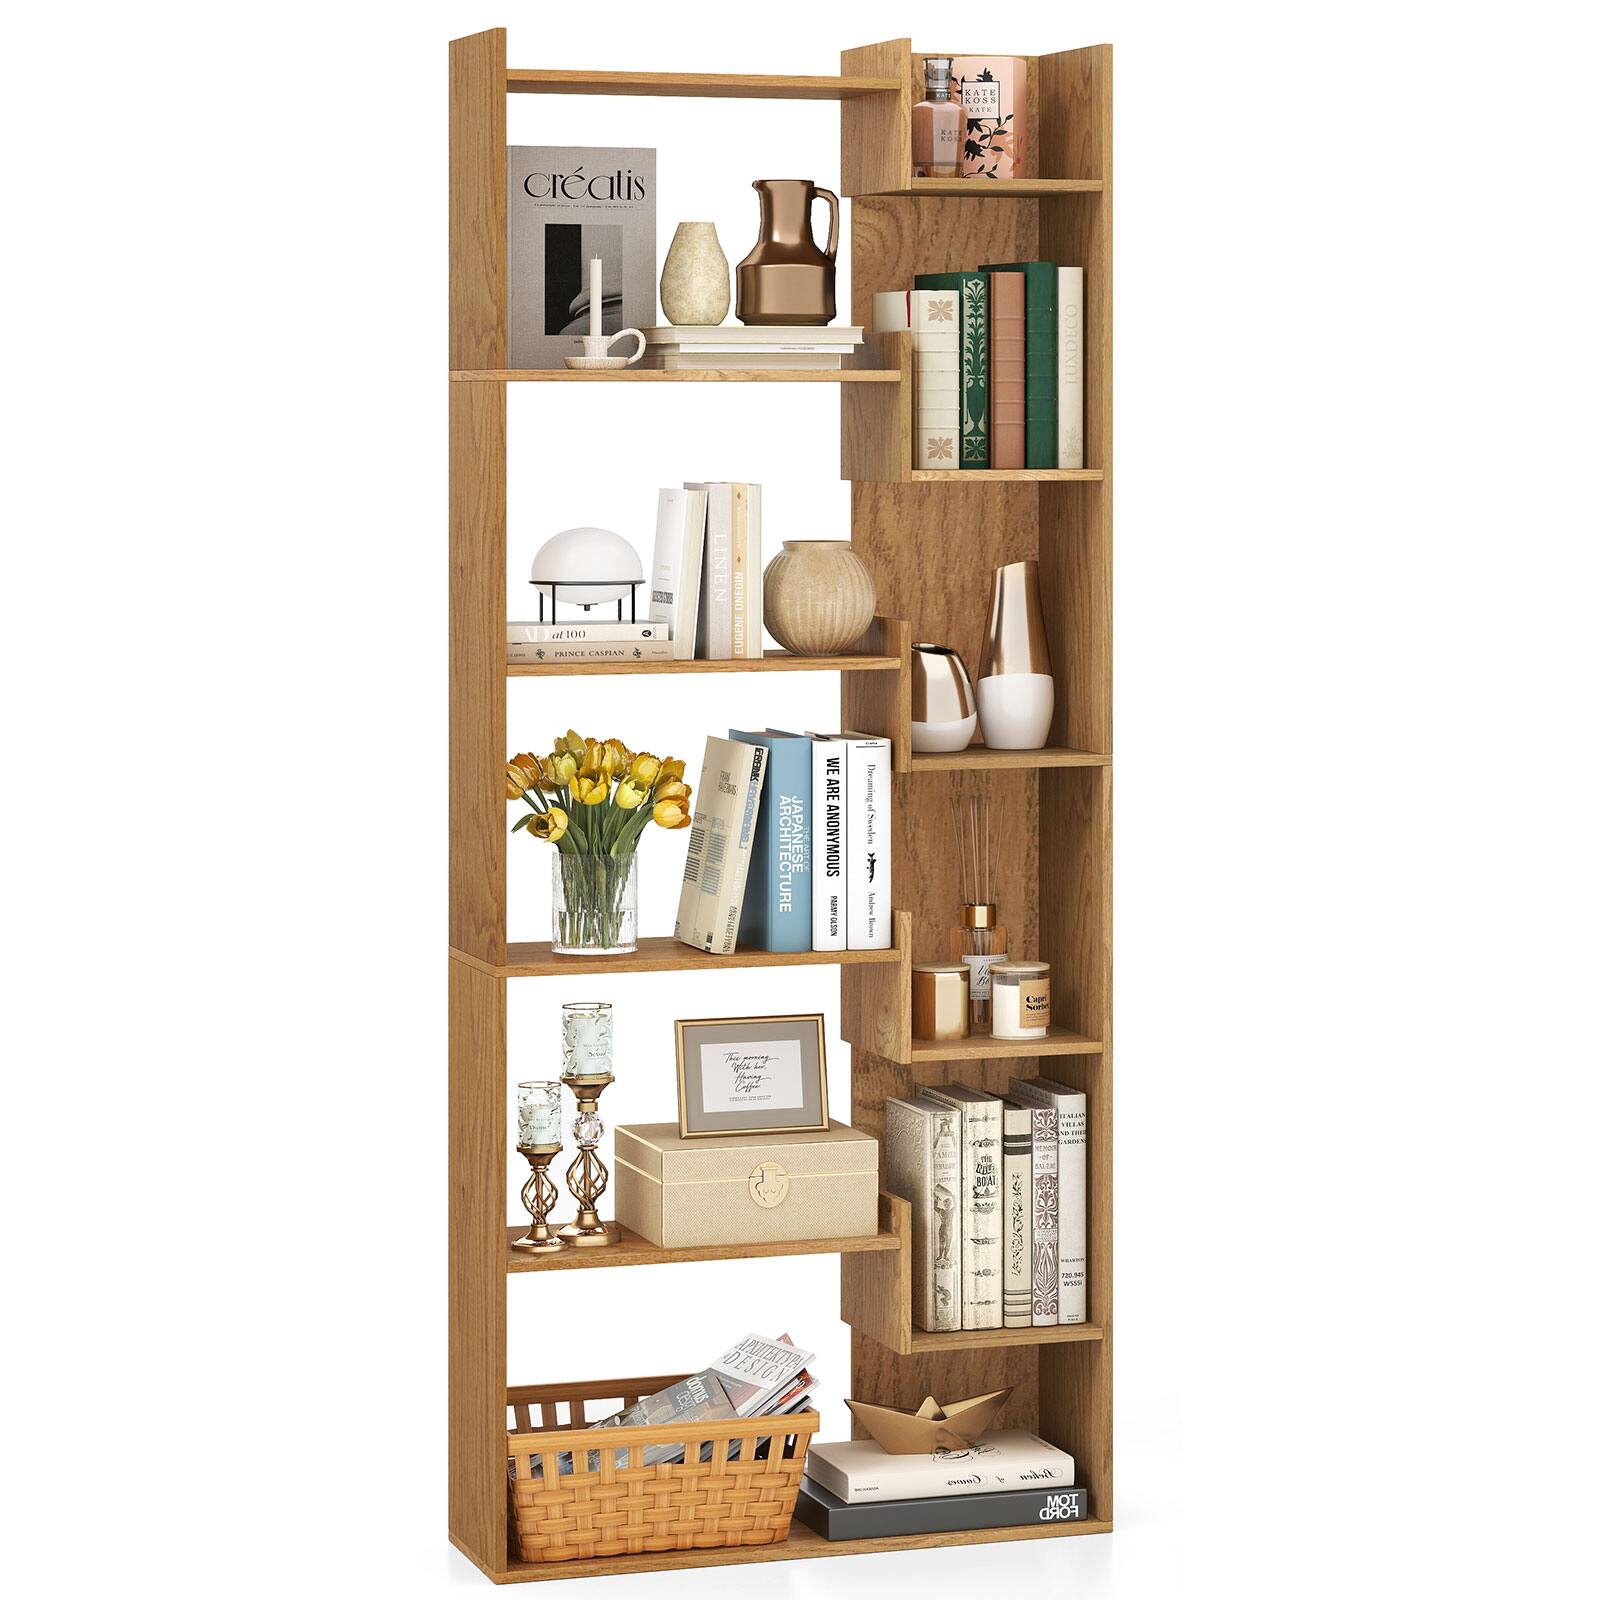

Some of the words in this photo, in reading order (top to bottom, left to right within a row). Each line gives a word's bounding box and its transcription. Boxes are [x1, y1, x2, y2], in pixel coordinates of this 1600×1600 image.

[523, 166, 646, 201] créatis
[714, 534, 728, 601] LINEN
[734, 571, 744, 611] ONEGIN
[566, 630, 586, 639] 100
[734, 613, 744, 655] EUGENE
[554, 650, 586, 658] PRINCE
[588, 649, 625, 657] CASPIAN
[826, 757, 840, 775] WE
[826, 778, 840, 801] ARE
[865, 764, 876, 802] Dreaming
[867, 804, 876, 813] of
[791, 795, 804, 873] JAPANESE
[826, 804, 840, 878] ANONYMOUS
[867, 814, 876, 845] Sweden
[779, 795, 792, 913] ARCHITECTURE
[830, 917, 838, 937] OLSON
[868, 917, 876, 938] Brown
[731, 1060, 751, 1073] With
[723, 1350, 791, 1382] DESIGN
[686, 1375, 709, 1405] domus
